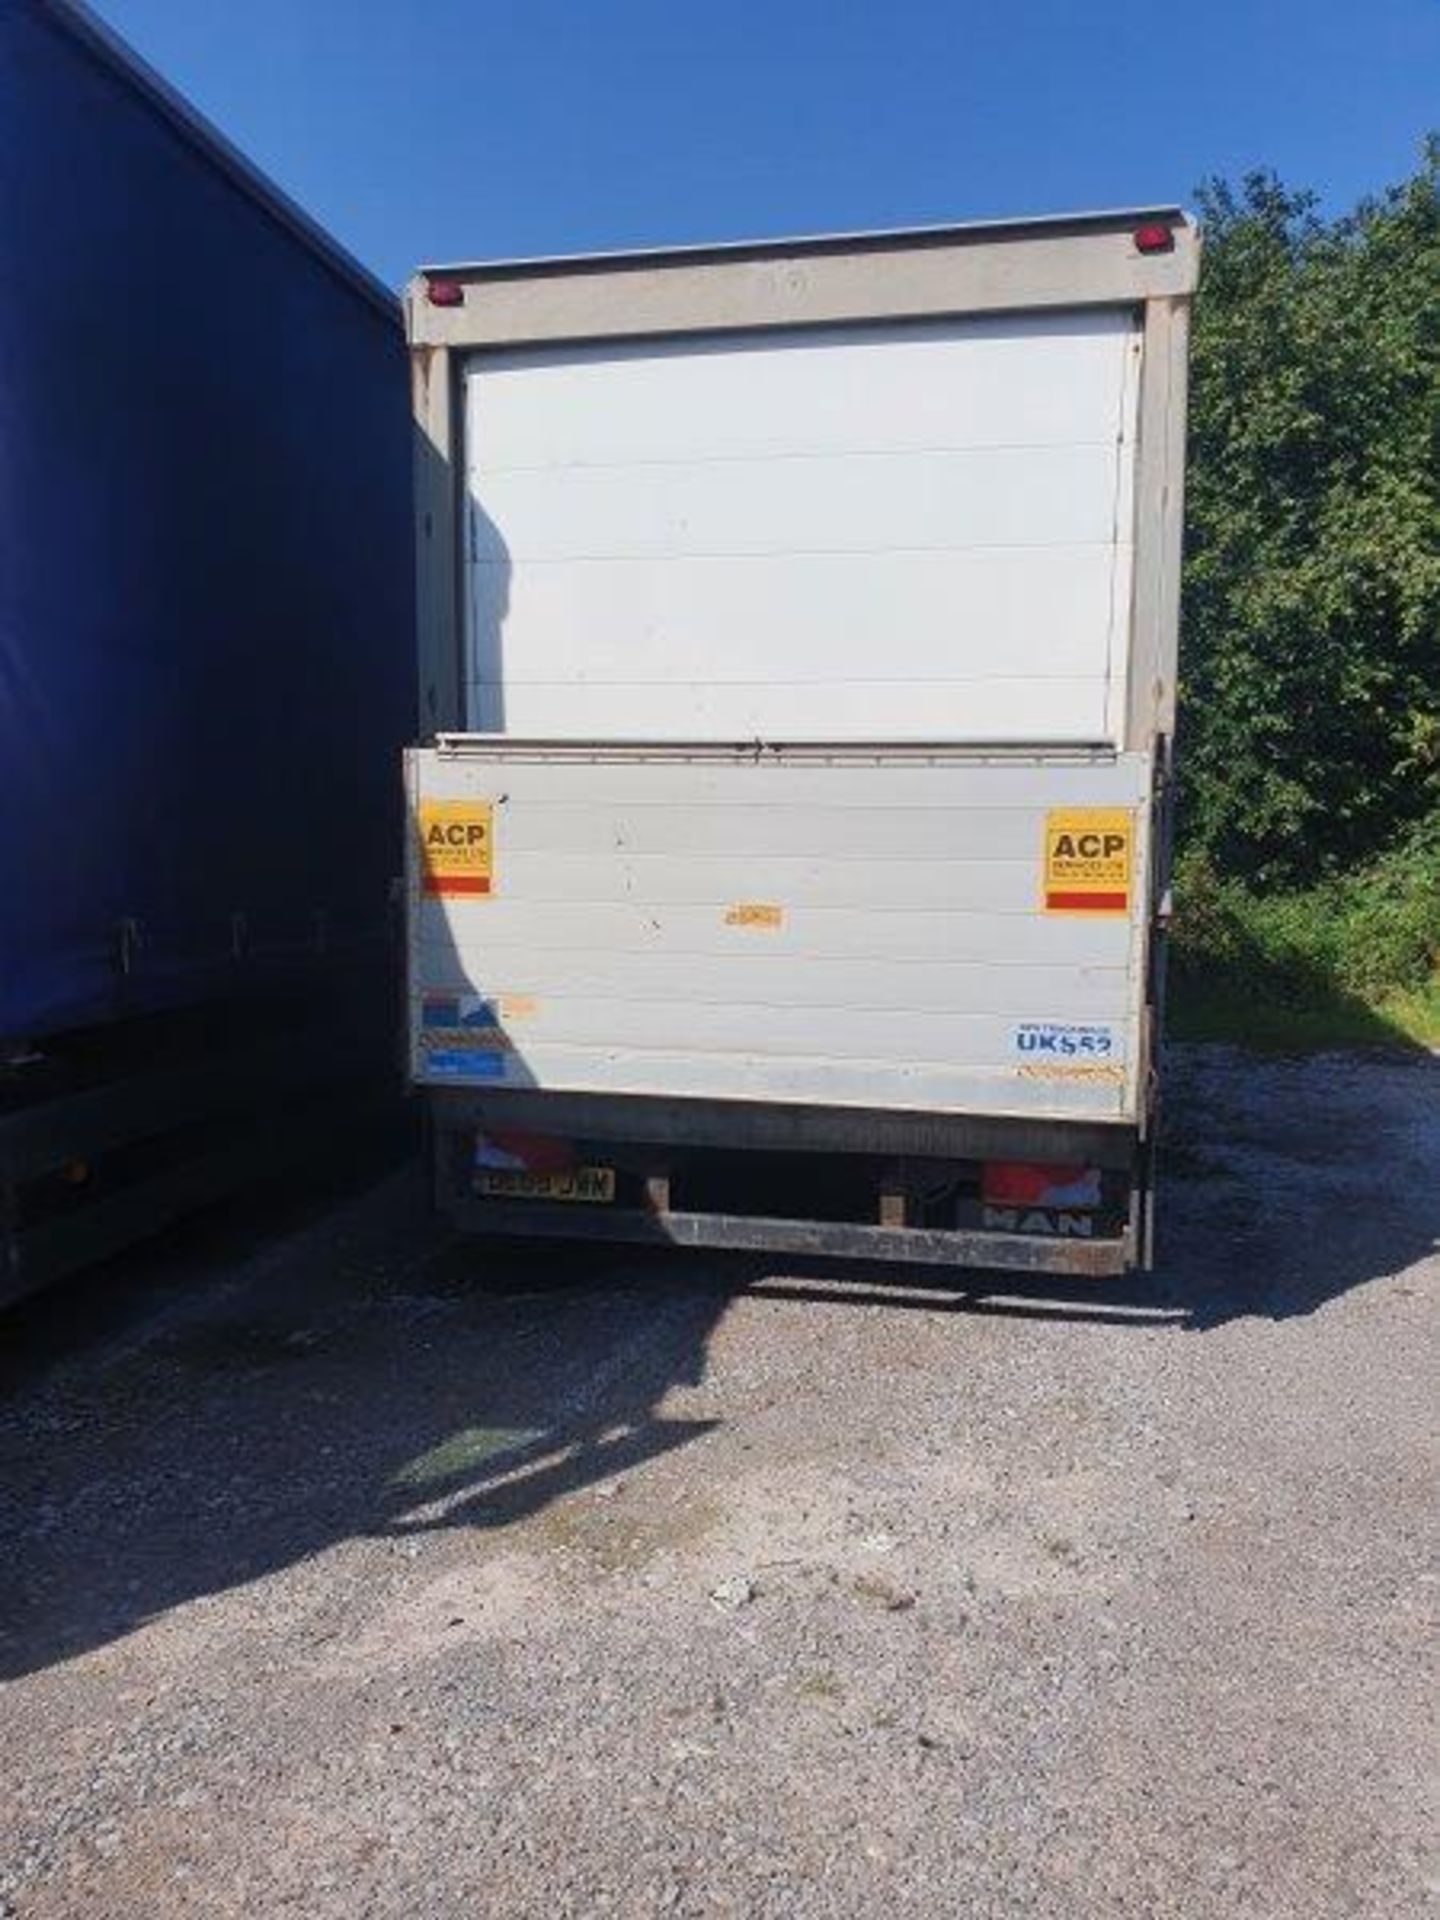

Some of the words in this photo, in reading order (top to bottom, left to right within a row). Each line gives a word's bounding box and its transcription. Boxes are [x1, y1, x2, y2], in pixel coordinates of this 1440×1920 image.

[428, 824, 485, 846] ACP
[1053, 834, 1125, 858] ACP
[984, 1206, 1093, 1237] MAN
